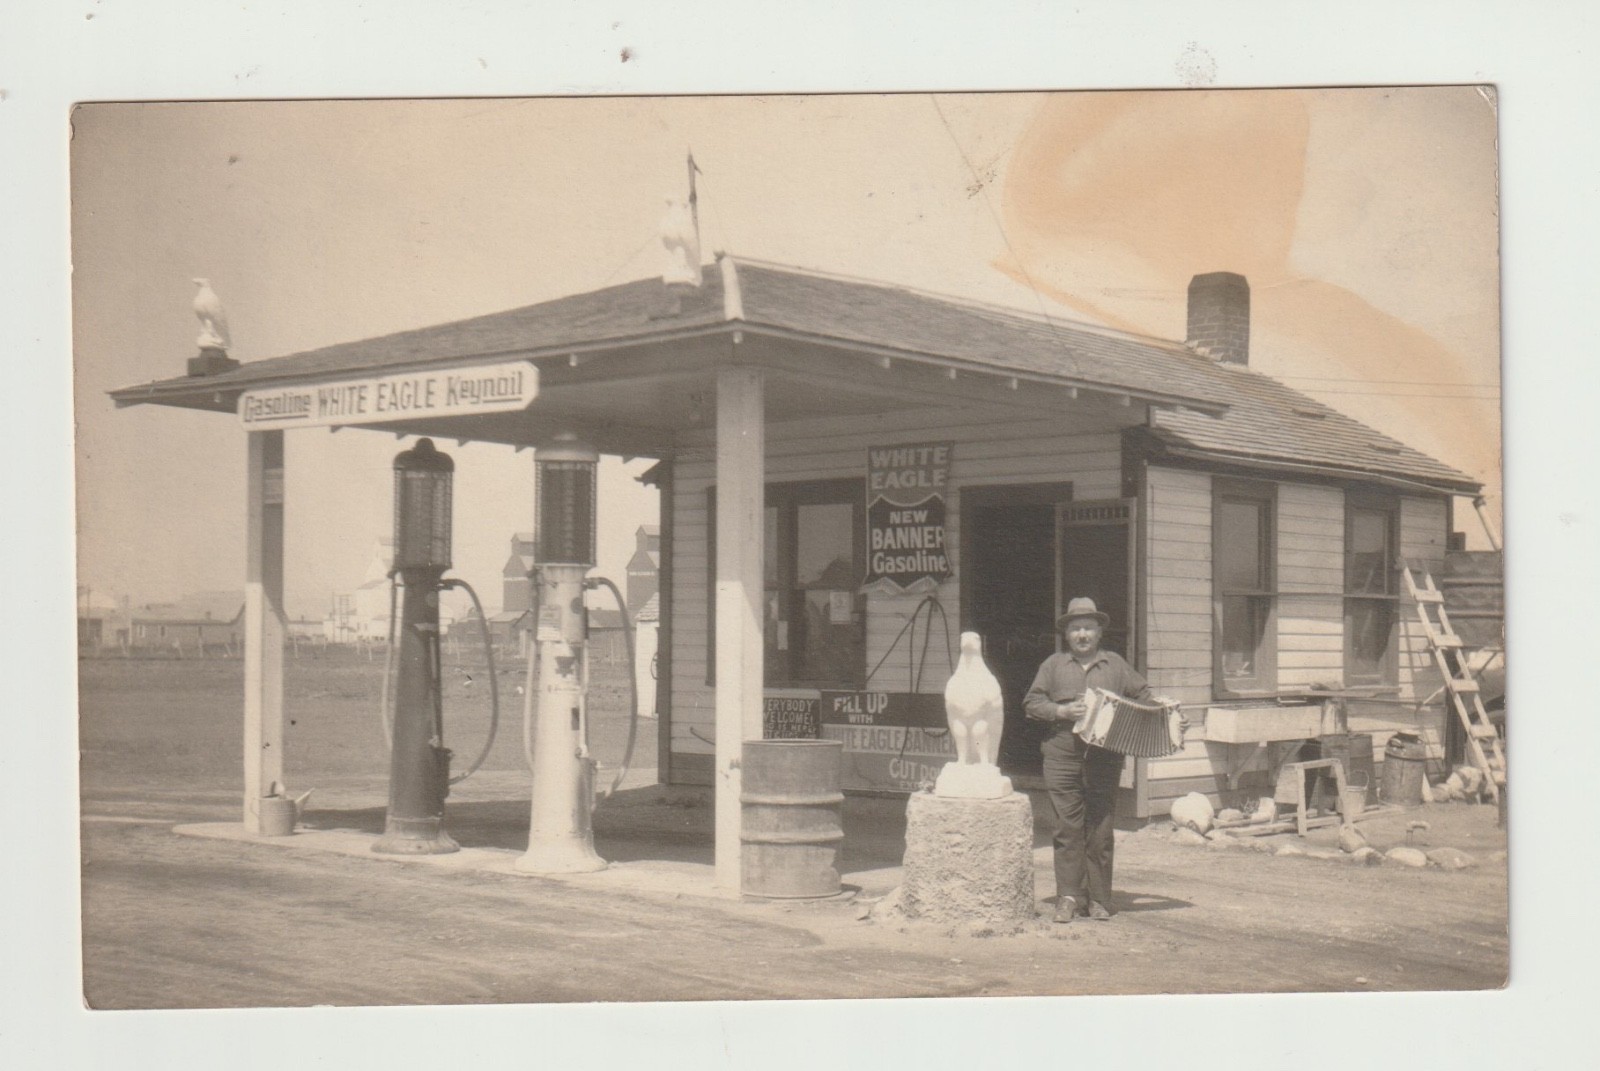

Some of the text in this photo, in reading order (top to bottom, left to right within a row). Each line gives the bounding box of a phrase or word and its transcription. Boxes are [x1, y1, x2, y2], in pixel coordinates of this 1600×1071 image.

[244, 371, 523, 422] Gasoline WHITE EAGLE Keynoil
[870, 446, 949, 467] WHITE
[871, 468, 946, 489] EAGLE
[890, 510, 928, 524] NEW
[873, 551, 948, 574] Gasoline
[834, 693, 888, 714] FILL UP
[848, 714, 873, 724] WITH
[861, 729, 902, 752] EAGLE
[889, 757, 918, 780] CUT
